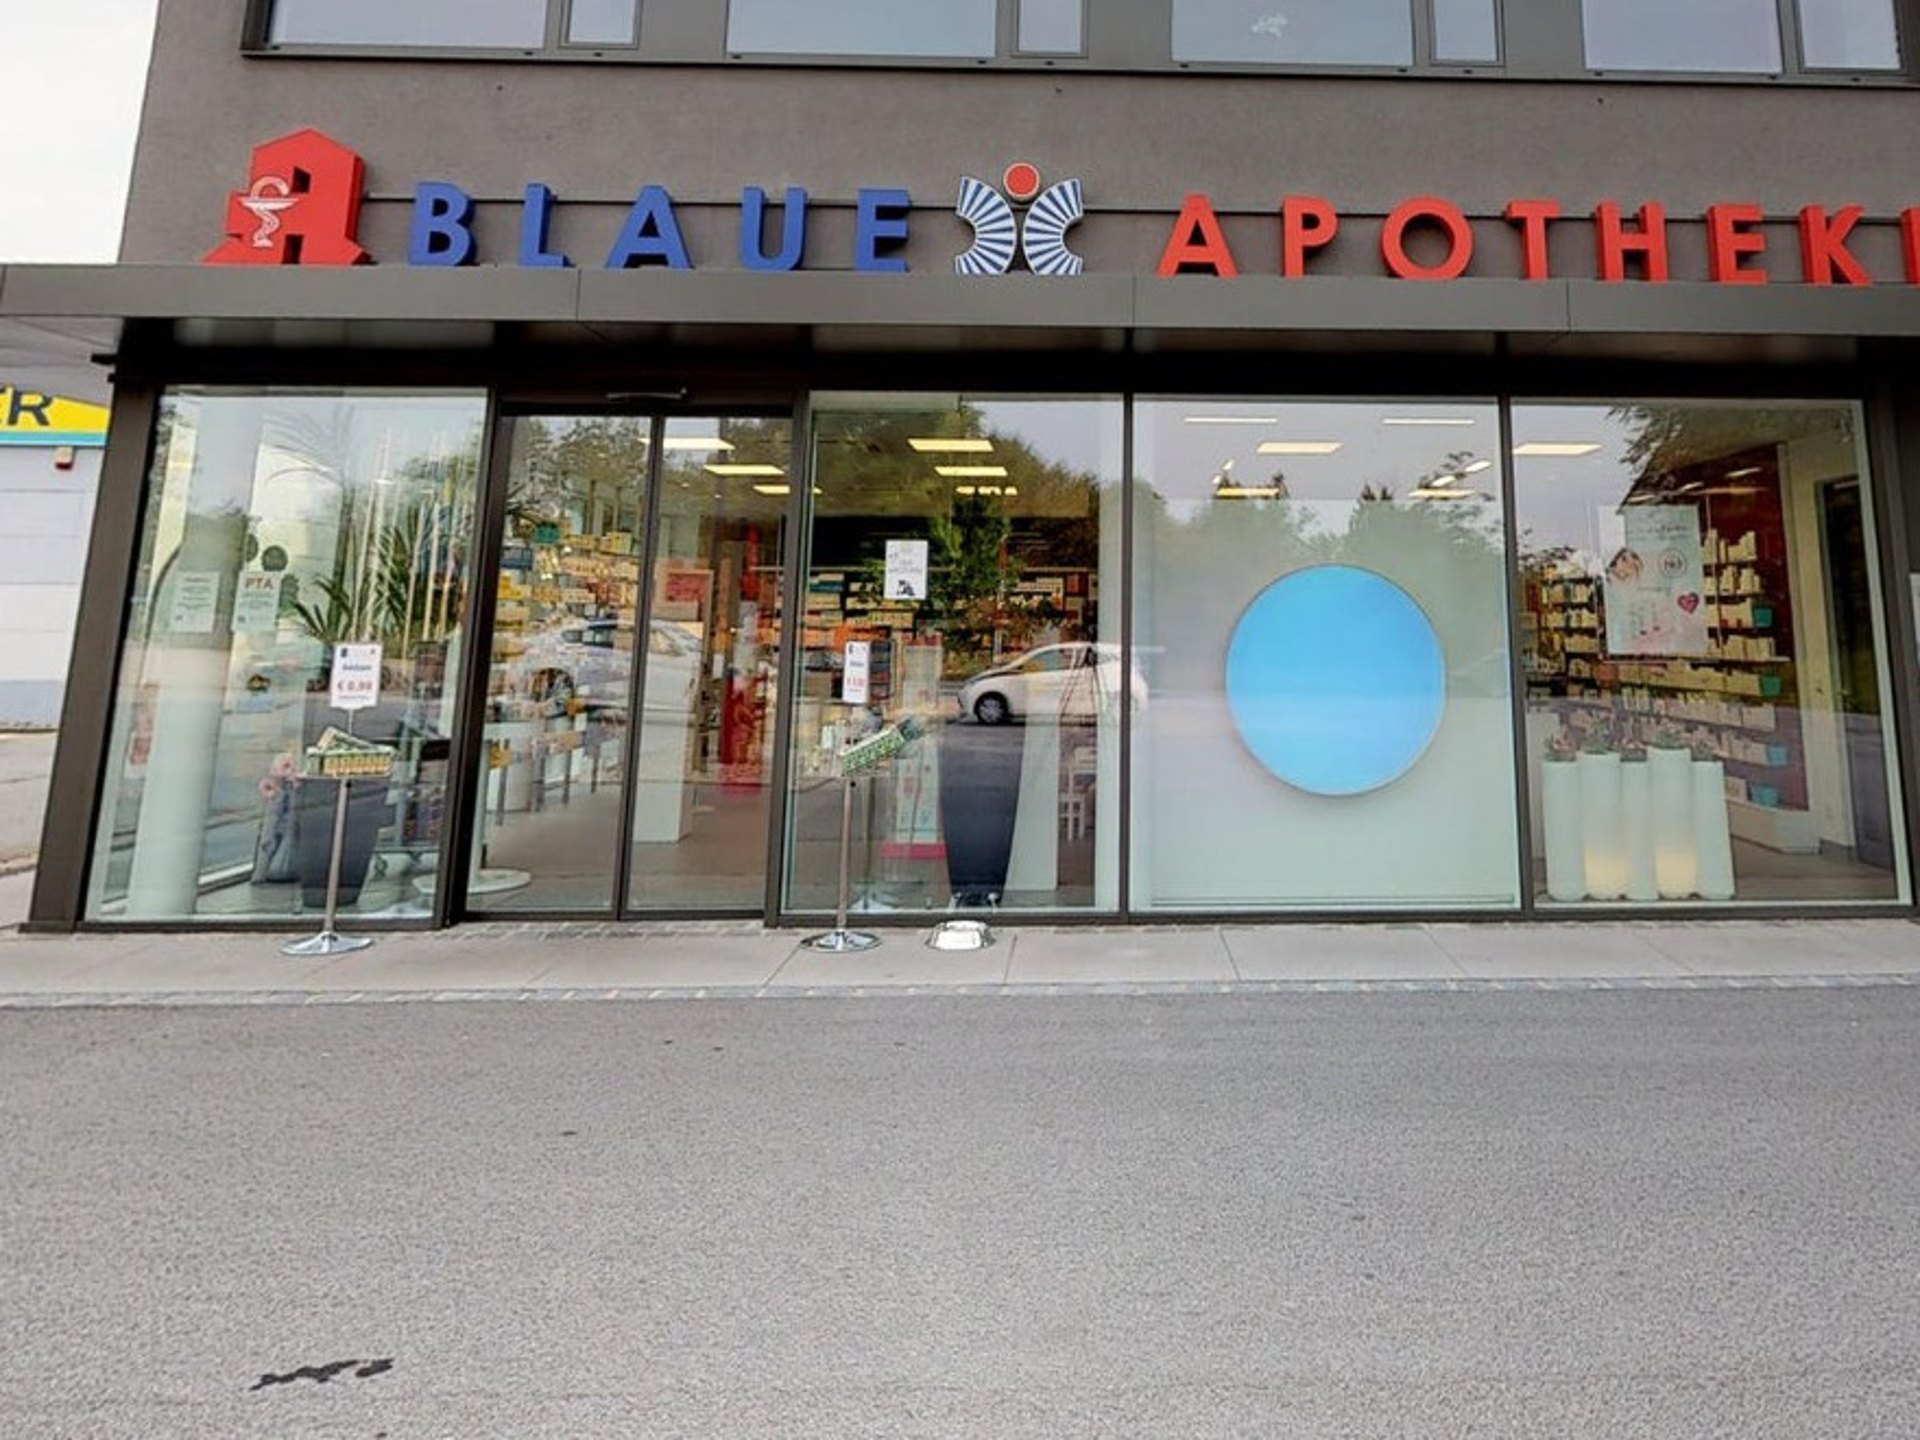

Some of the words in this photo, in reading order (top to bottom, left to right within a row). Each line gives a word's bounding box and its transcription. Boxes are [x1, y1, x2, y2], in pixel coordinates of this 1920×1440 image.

[407, 181, 911, 271] BLAUE
[0, 387, 53, 426] R
[245, 577, 273, 590] PTA
